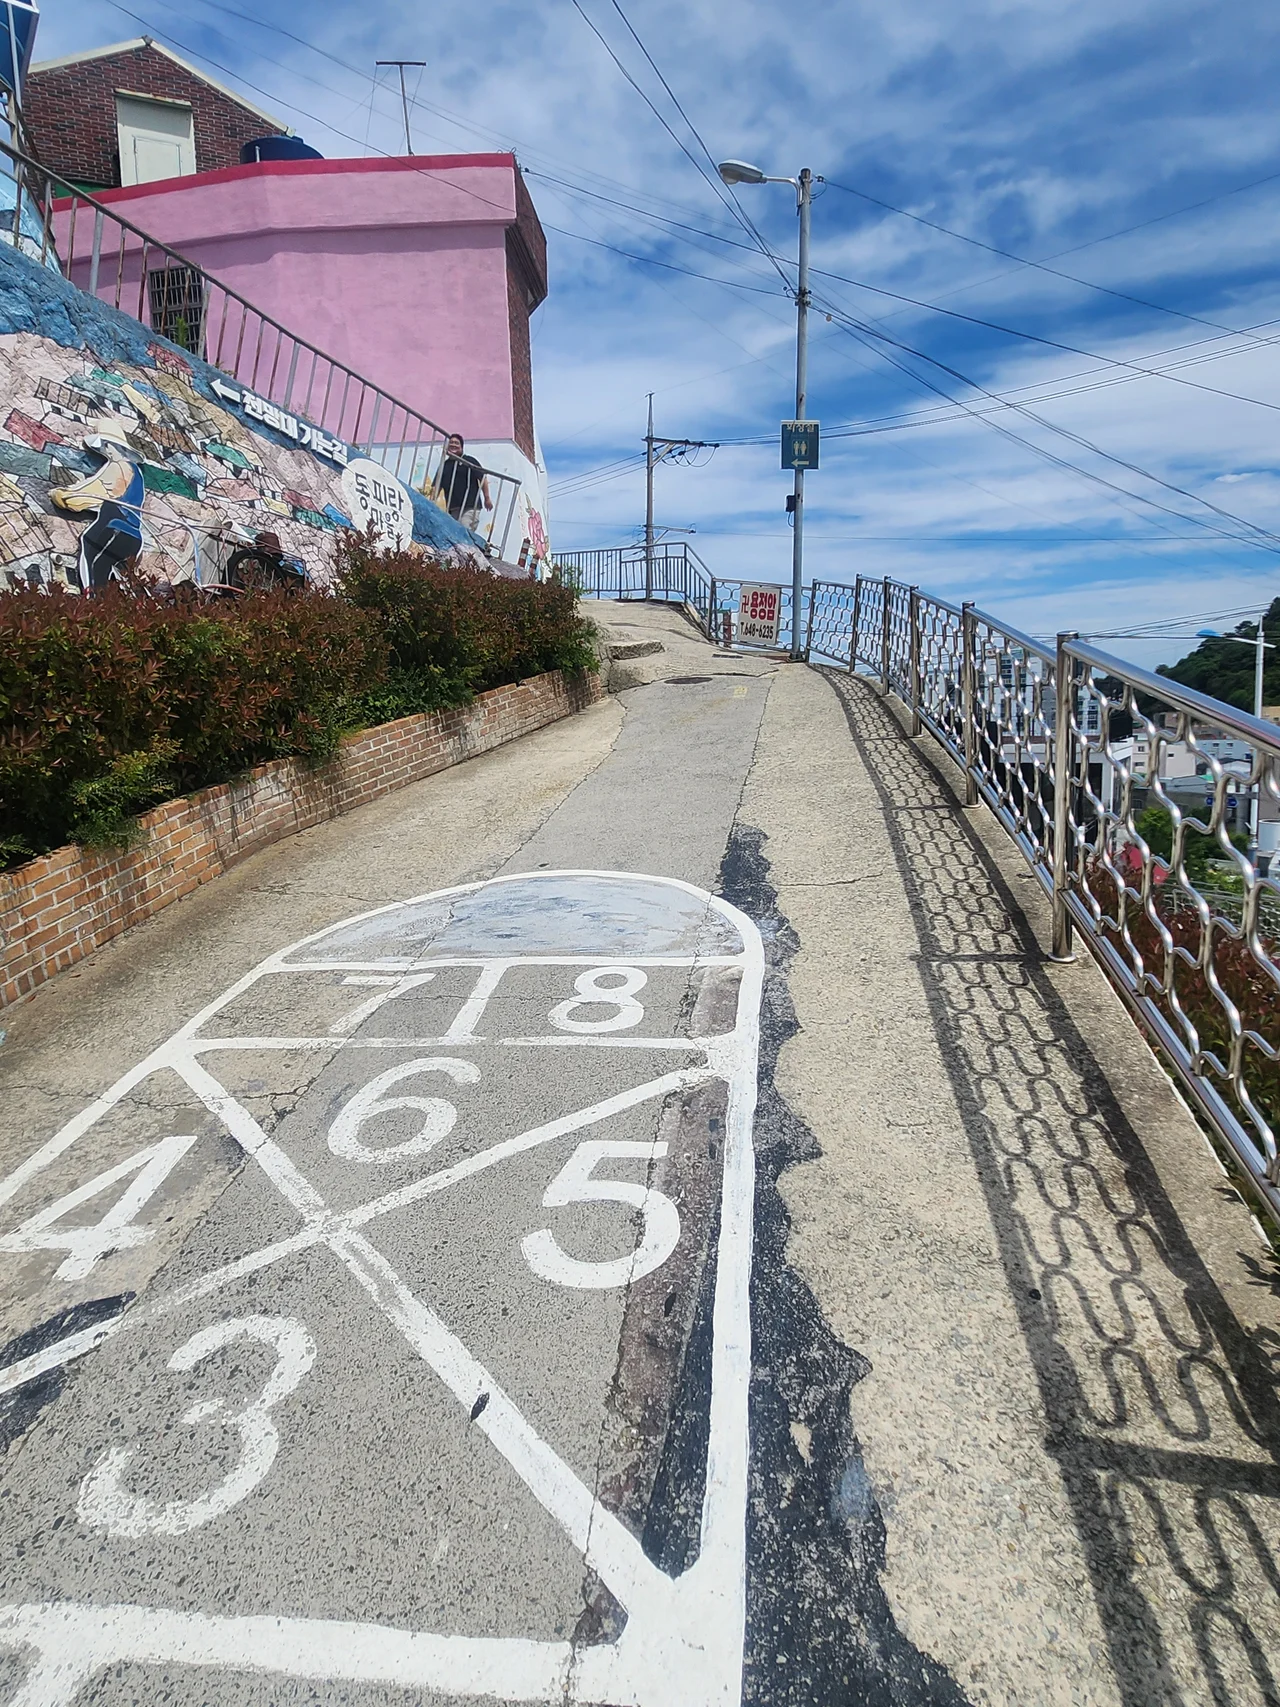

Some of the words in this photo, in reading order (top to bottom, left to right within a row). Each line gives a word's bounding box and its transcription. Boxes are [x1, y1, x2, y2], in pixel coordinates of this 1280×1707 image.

[242, 390, 298, 439] 전망대
[355, 472, 404, 522] 동피랑
[371, 507, 394, 540] 마을
[343, 972, 435, 1033] 7
[547, 966, 648, 1032] 8
[328, 1057, 481, 1164] 6
[0, 1136, 197, 1281] 4
[521, 1140, 681, 1290] 5
[77, 1314, 317, 1537] 3
